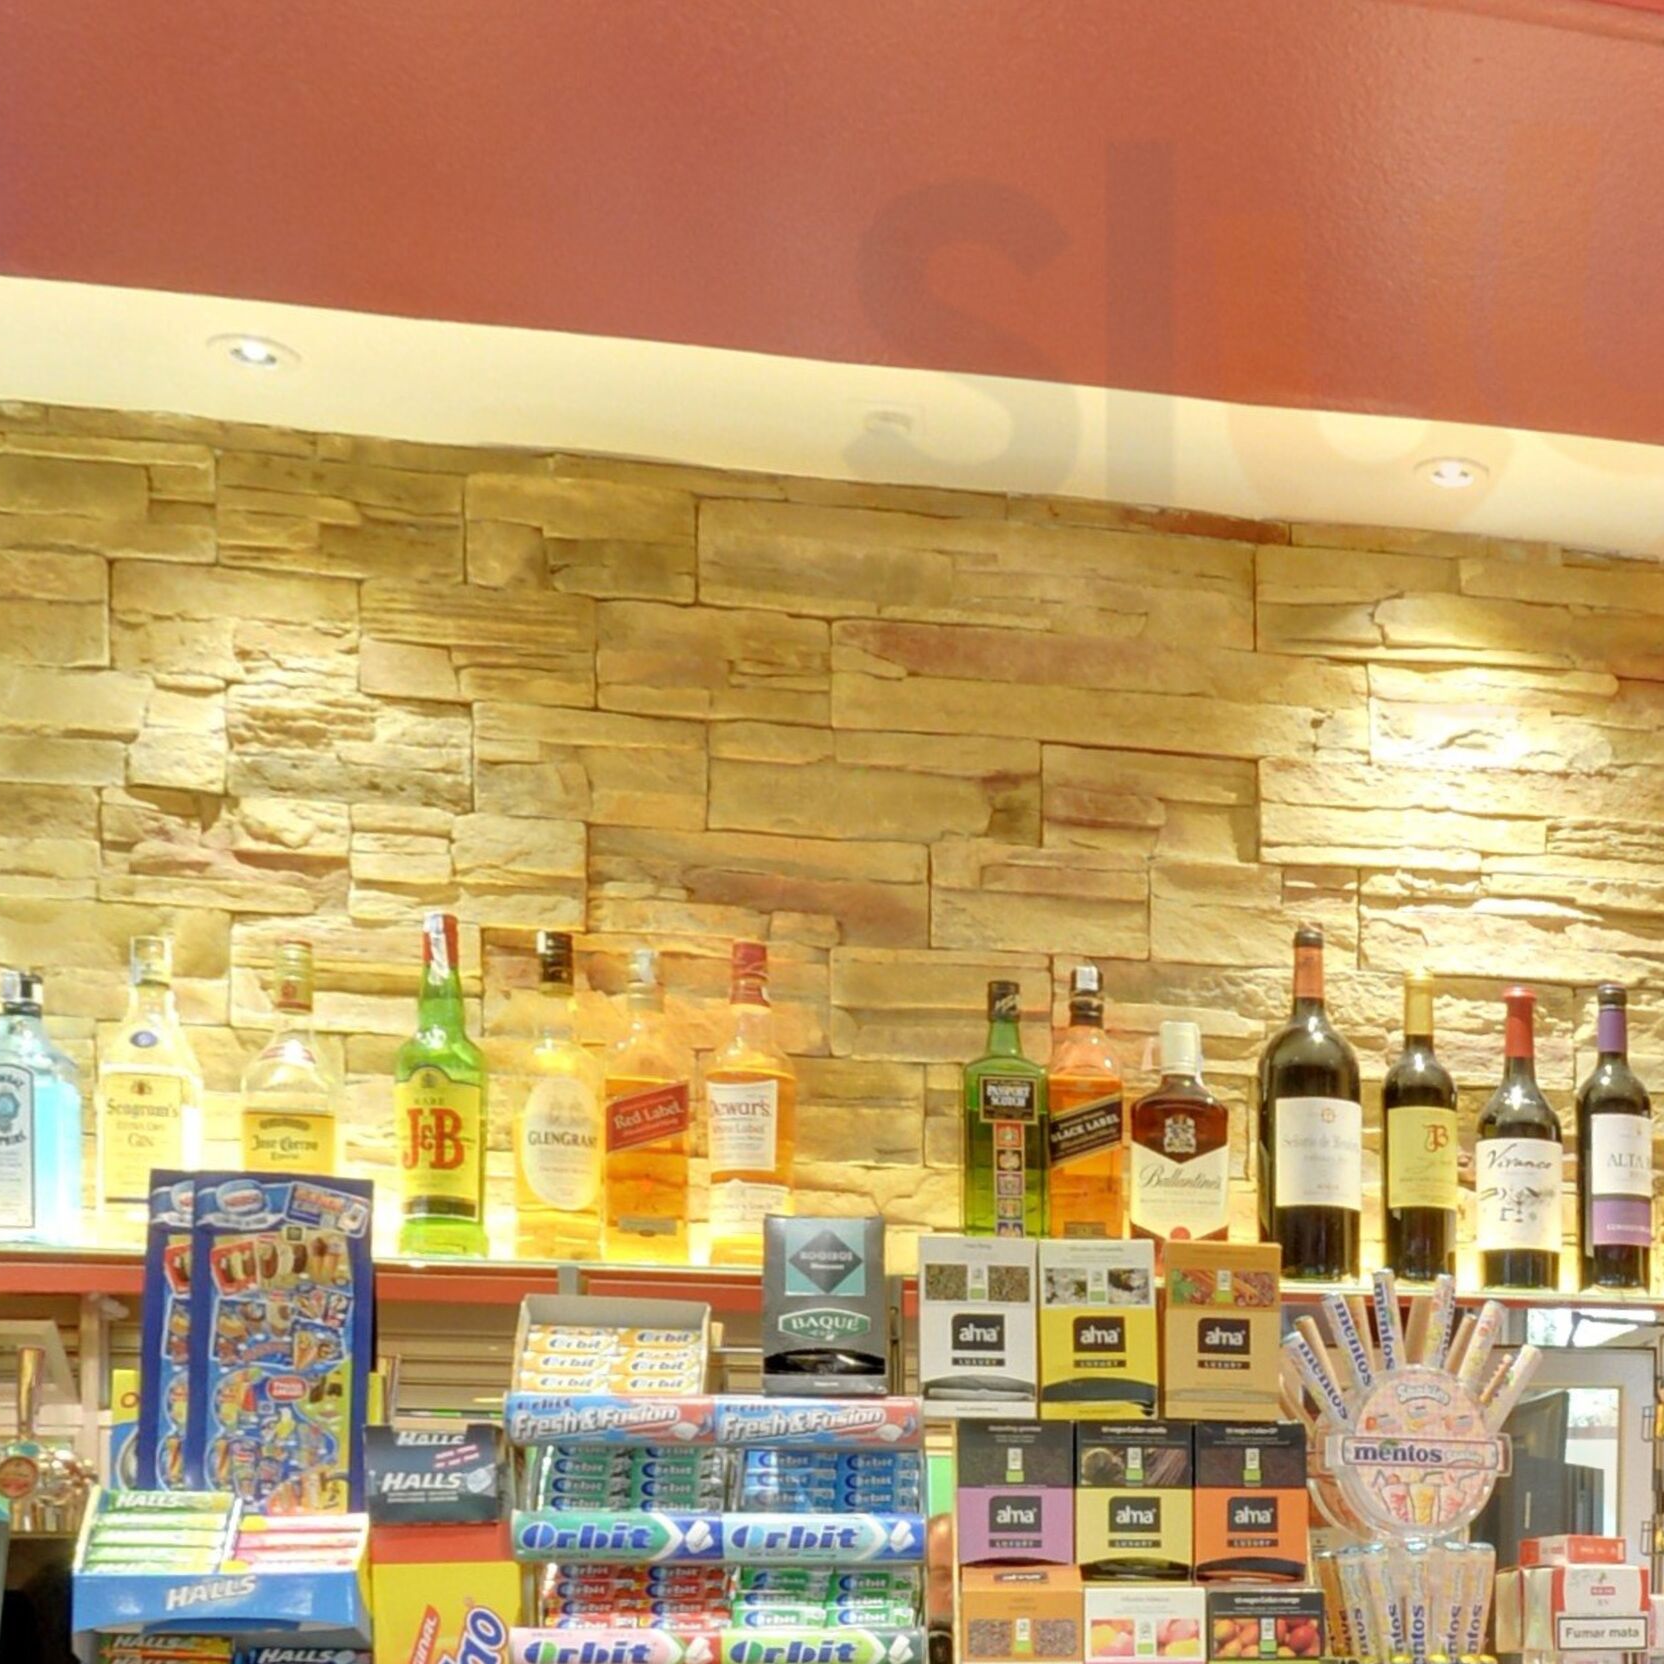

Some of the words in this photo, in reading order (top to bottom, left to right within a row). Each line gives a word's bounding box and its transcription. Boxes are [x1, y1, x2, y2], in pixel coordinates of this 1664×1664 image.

[613, 1110, 636, 1131] Red
[1084, 1112, 1120, 1134] LABEL
[402, 1106, 464, 1171] J&B
[958, 1323, 1001, 1343] alma
[1079, 1325, 1122, 1345] alma
[1204, 1327, 1247, 1347] alma
[1335, 1301, 1373, 1388] mentos
[1298, 1341, 1348, 1421] mentos
[1353, 1443, 1443, 1464] mentos
[382, 1472, 462, 1490] HALLS
[995, 1505, 1038, 1525] alma
[1114, 1505, 1157, 1525] alma
[1233, 1505, 1275, 1525] alma
[522, 1522, 654, 1550] Orbit
[732, 1525, 859, 1549] Orbit
[166, 1576, 257, 1611] HALLS
[113, 1635, 179, 1650] HALLS
[1565, 1626, 1606, 1639] Fumar
[1609, 1625, 1641, 1639] mata
[259, 1649, 335, 1664] HALLS
[524, 1642, 652, 1664] Orbit
[729, 1640, 858, 1664] Orbit
